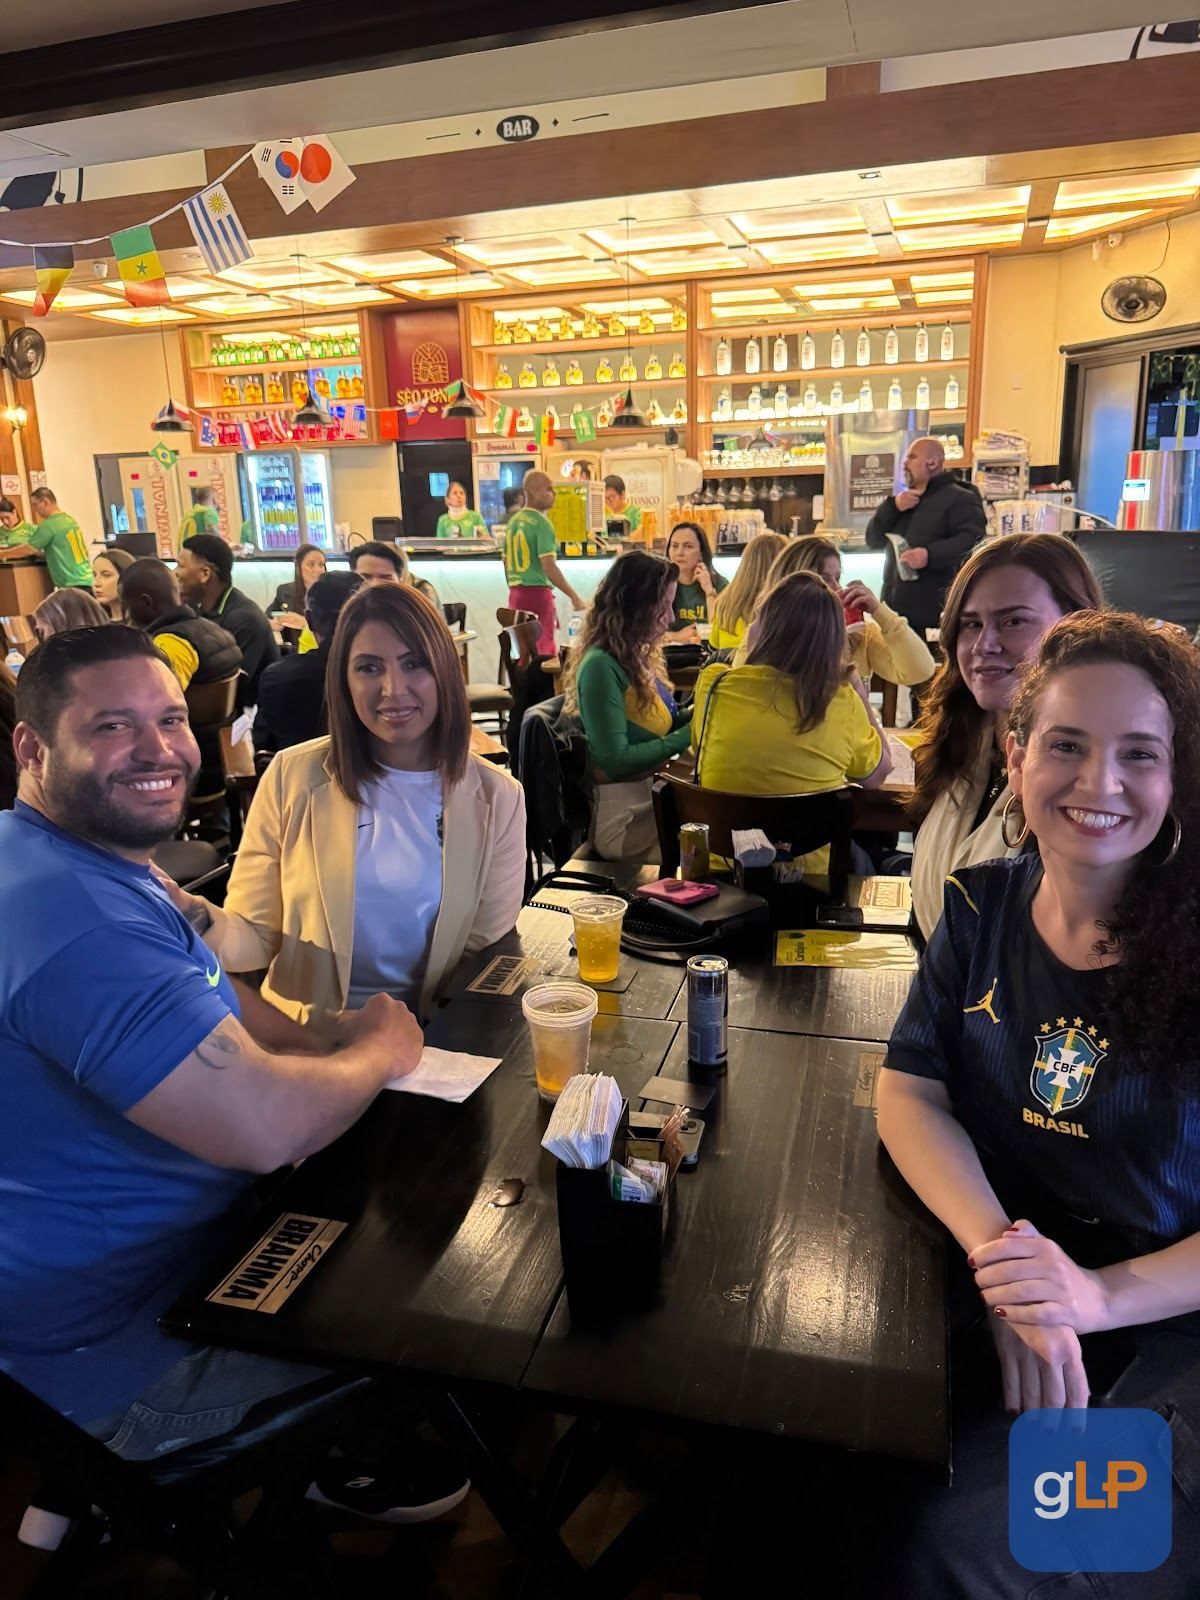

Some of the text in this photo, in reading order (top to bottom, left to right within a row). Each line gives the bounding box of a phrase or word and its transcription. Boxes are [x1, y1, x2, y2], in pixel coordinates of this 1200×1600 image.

[502, 119, 533, 138] BAR
[506, 529, 530, 573] 10
[1053, 1061, 1077, 1074] CBF
[1022, 1107, 1089, 1139] BRASIL
[221, 1218, 320, 1301] BRAHMA
[285, 1244, 322, 1289] Chopp
